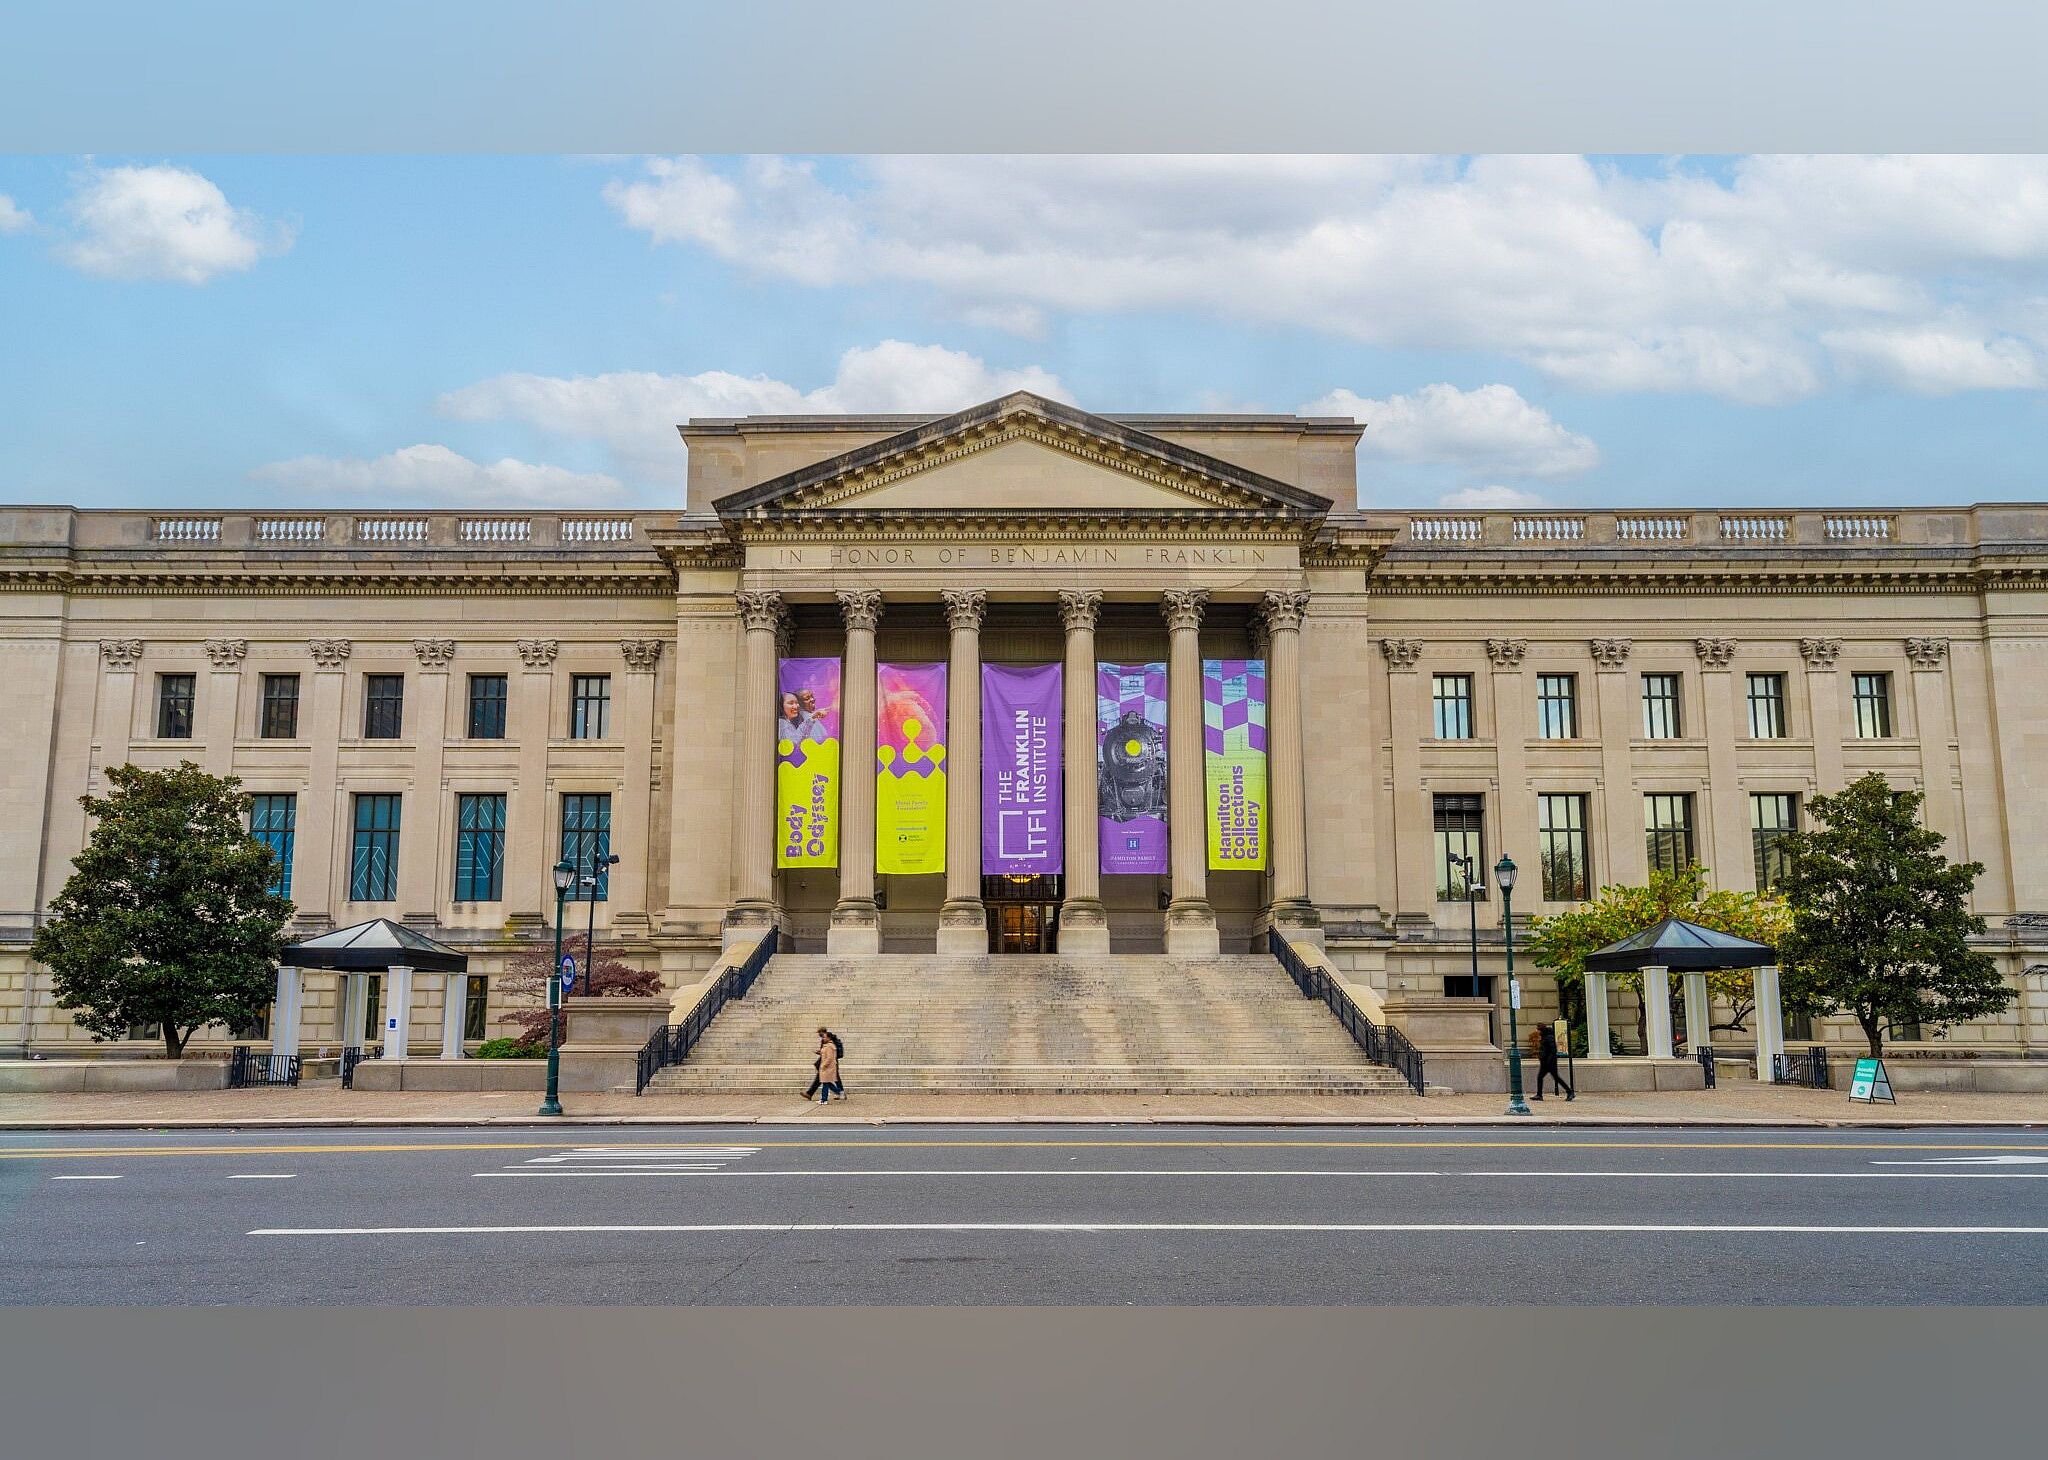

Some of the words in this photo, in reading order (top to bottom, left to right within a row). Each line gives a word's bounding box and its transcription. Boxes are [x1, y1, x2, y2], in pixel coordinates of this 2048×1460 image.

[780, 549, 802, 563] IN
[830, 549, 915, 563] HONOR
[939, 549, 966, 563] OF
[991, 548, 1118, 563] BENJAMIN
[1146, 548, 1265, 563] FRANKLIN
[999, 771, 1012, 804] THE
[1016, 710, 1029, 803] FRANKLIN
[1033, 716, 1047, 802] INSTITUTE
[785, 804, 807, 857] Body
[806, 773, 829, 857] Odyssey
[1129, 840, 1137, 848] H
[1217, 783, 1231, 859] Hamilton
[1231, 765, 1246, 859] Collections
[1245, 800, 1260, 859] Gallery
